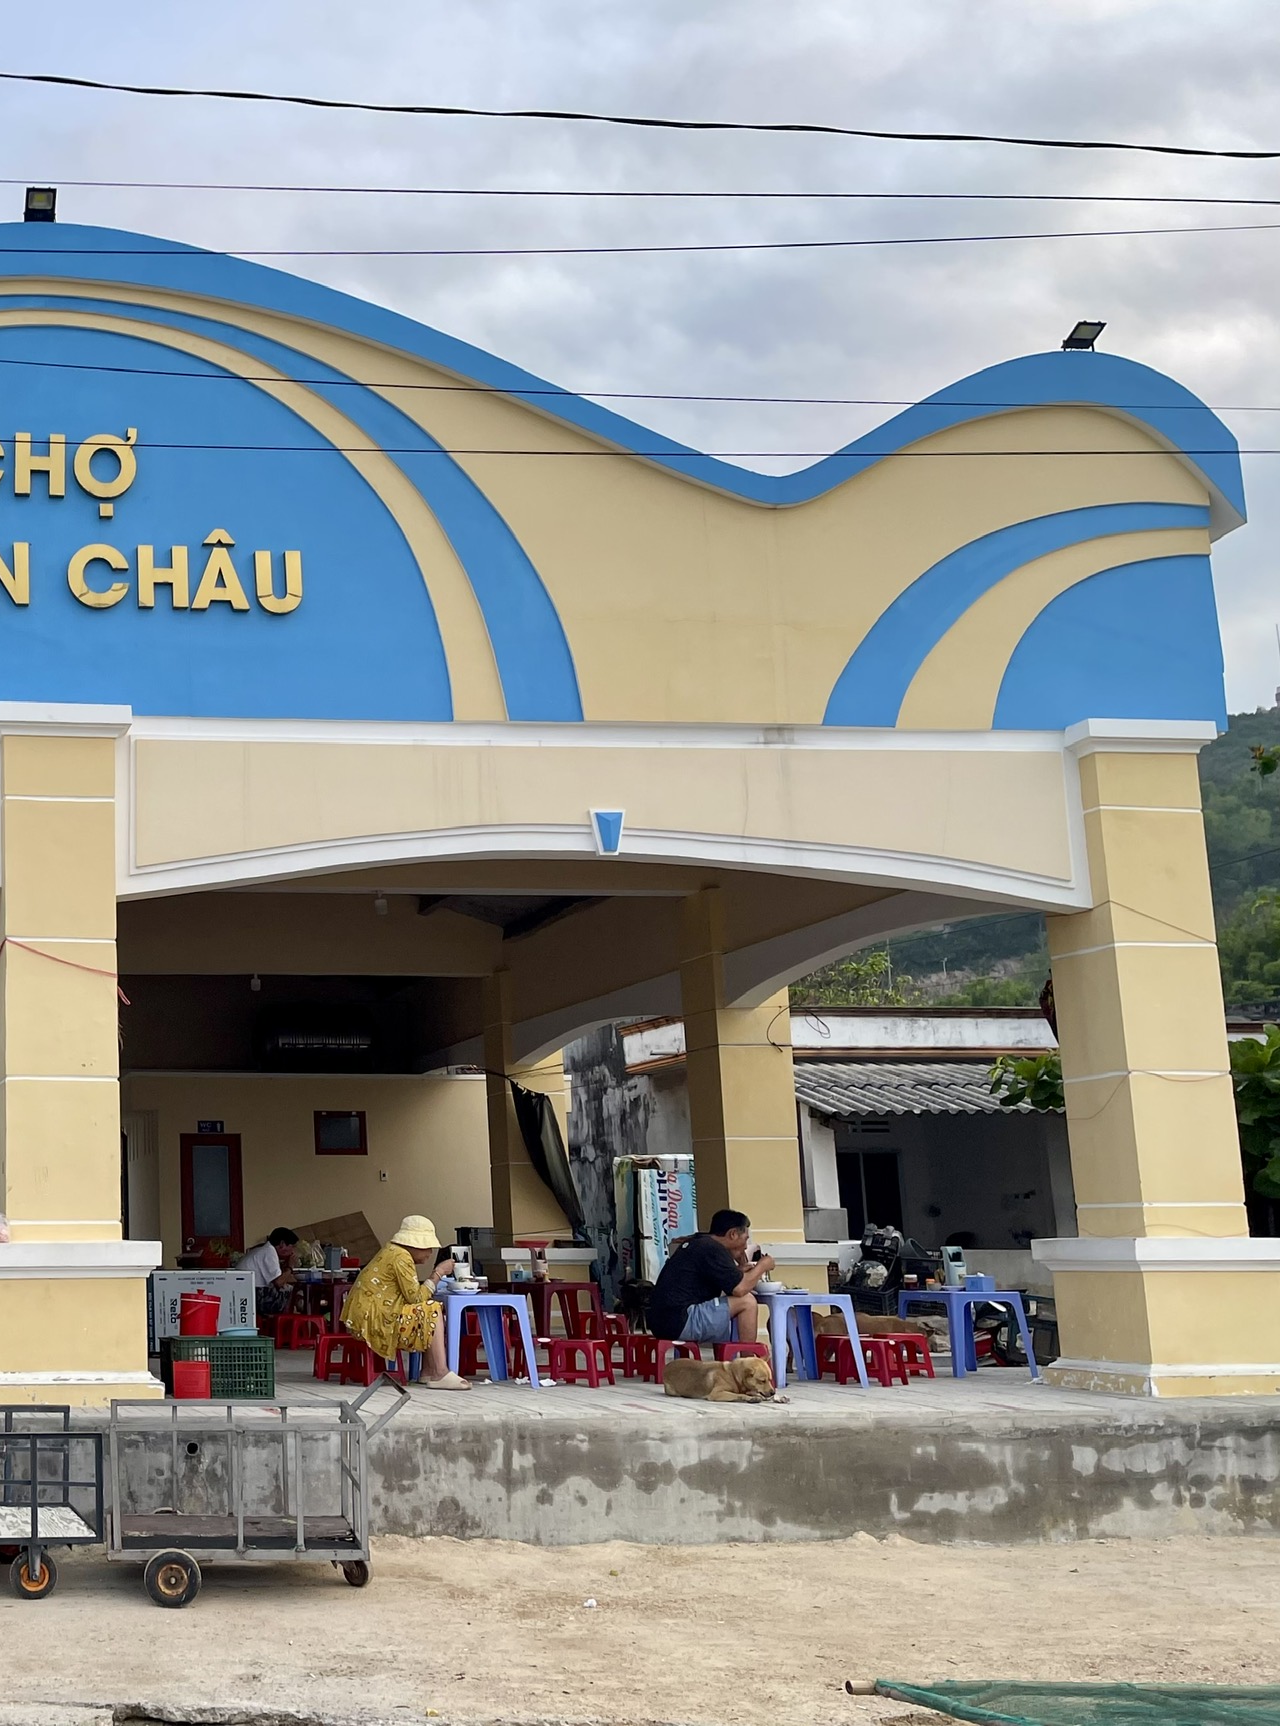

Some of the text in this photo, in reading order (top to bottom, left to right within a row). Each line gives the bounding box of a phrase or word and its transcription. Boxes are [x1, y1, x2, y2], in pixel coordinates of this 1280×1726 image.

[66, 528, 304, 615] CHÂU
[170, 1298, 178, 1324] Reto
[239, 1298, 248, 1324] Reto
